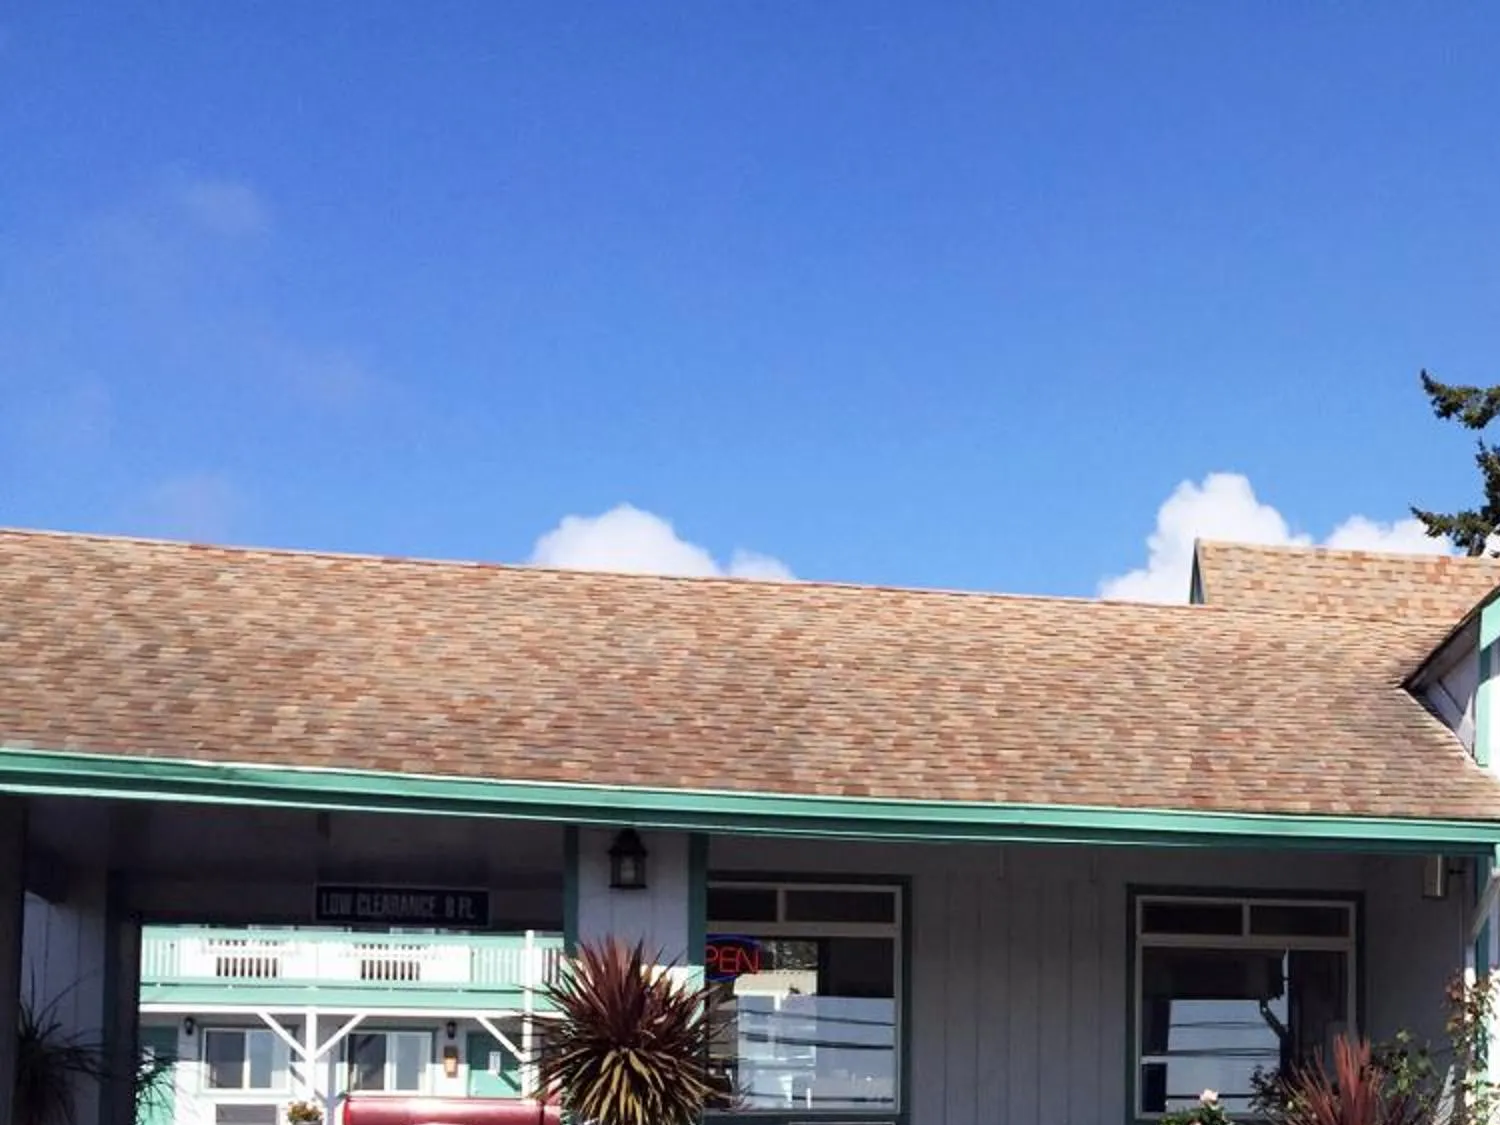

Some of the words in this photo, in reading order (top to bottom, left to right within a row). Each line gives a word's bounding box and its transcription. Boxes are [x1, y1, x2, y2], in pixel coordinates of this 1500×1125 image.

[322, 893, 352, 915] LOW
[357, 894, 436, 917] CLEARANCE
[705, 945, 760, 975] PEN
